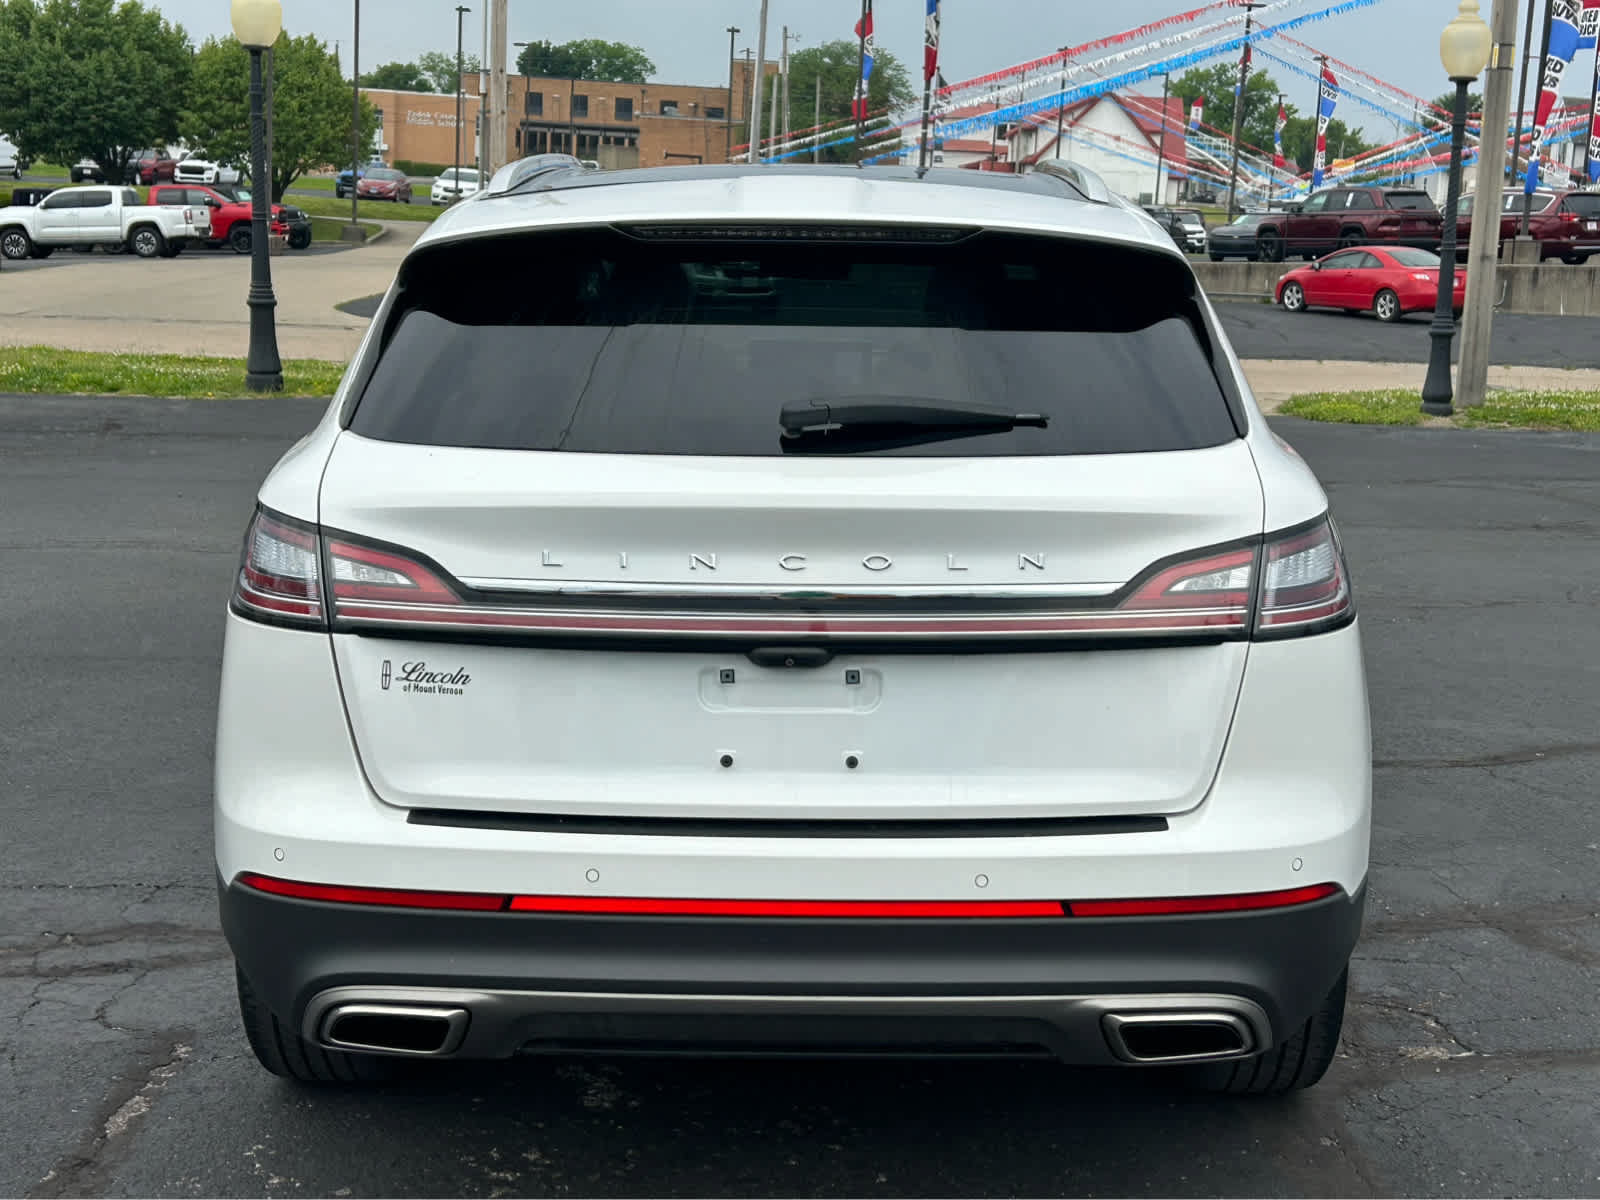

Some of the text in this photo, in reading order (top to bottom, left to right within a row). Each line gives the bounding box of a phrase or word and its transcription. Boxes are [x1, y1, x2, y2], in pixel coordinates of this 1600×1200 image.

[541, 549, 1046, 572] LINCOLN
[395, 661, 471, 685] Lincoln
[402, 683, 463, 695] of Mount Vernon
